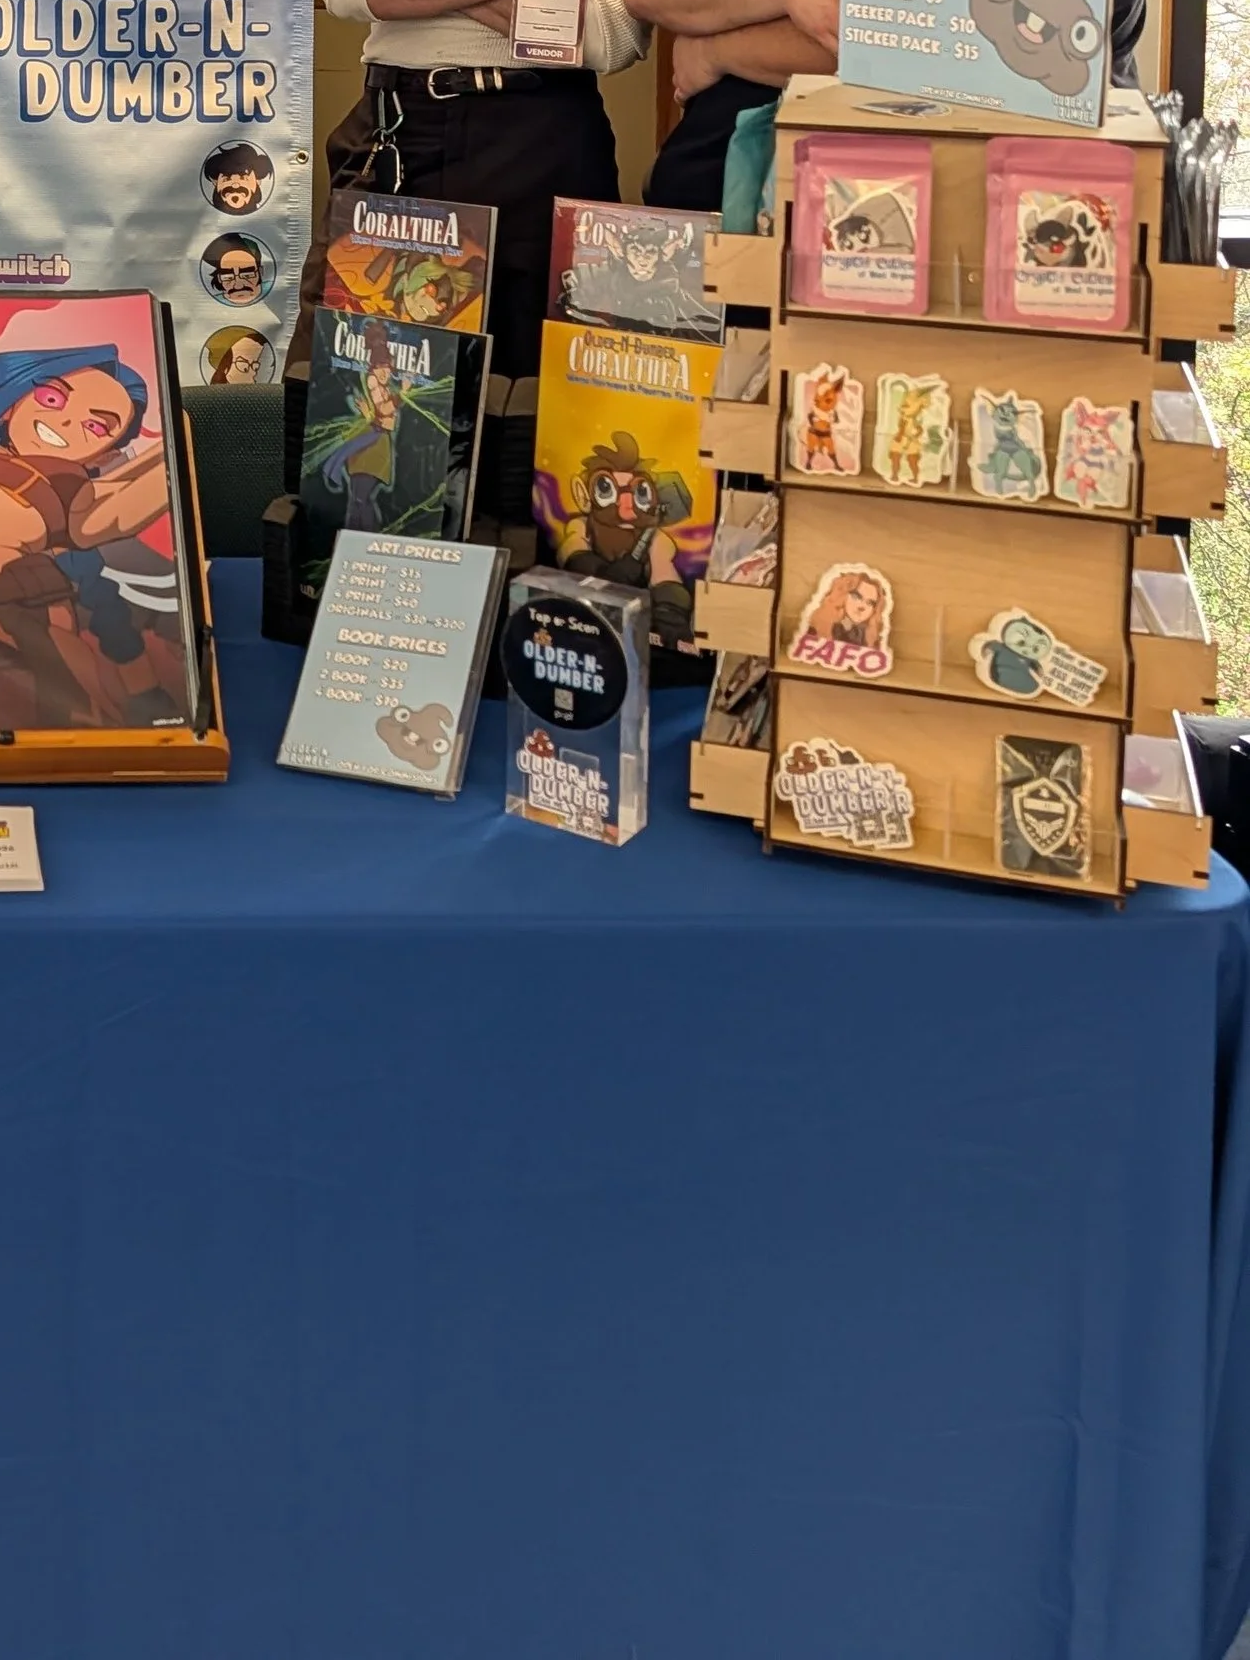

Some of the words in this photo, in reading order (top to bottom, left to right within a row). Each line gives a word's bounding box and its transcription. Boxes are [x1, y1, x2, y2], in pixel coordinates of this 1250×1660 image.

[846, 4, 895, 23] PEEKER
[897, 9, 937, 29] PACK
[949, 16, 977, 36] $10
[526, 47, 564, 58] VENDOR
[845, 27, 899, 48] STICKER
[902, 35, 941, 55] PACK
[954, 42, 980, 61] $15
[20, 59, 276, 123] DUMBER
[353, 200, 459, 246] CORALTHEA
[569, 336, 689, 391] CORALTHEA
[367, 539, 401, 556] ART
[403, 543, 462, 563] PRICES
[349, 575, 386, 589] PRINT
[351, 561, 388, 575] PRINT
[345, 590, 382, 603] PRINT
[326, 603, 393, 620] ORIGINALS
[528, 607, 551, 627] Tap
[567, 616, 601, 636] Scan
[338, 628, 385, 646] BOOK
[388, 635, 448, 656] PRICES
[523, 640, 604, 672] OLDER-N-
[792, 634, 888, 674] FAFO
[333, 651, 371, 666] BOOK
[382, 657, 408, 672] $20
[331, 670, 368, 685] BOOK
[534, 661, 606, 695] DUMBER
[326, 687, 363, 703] BOOK
[530, 774, 610, 818] DUMBER
